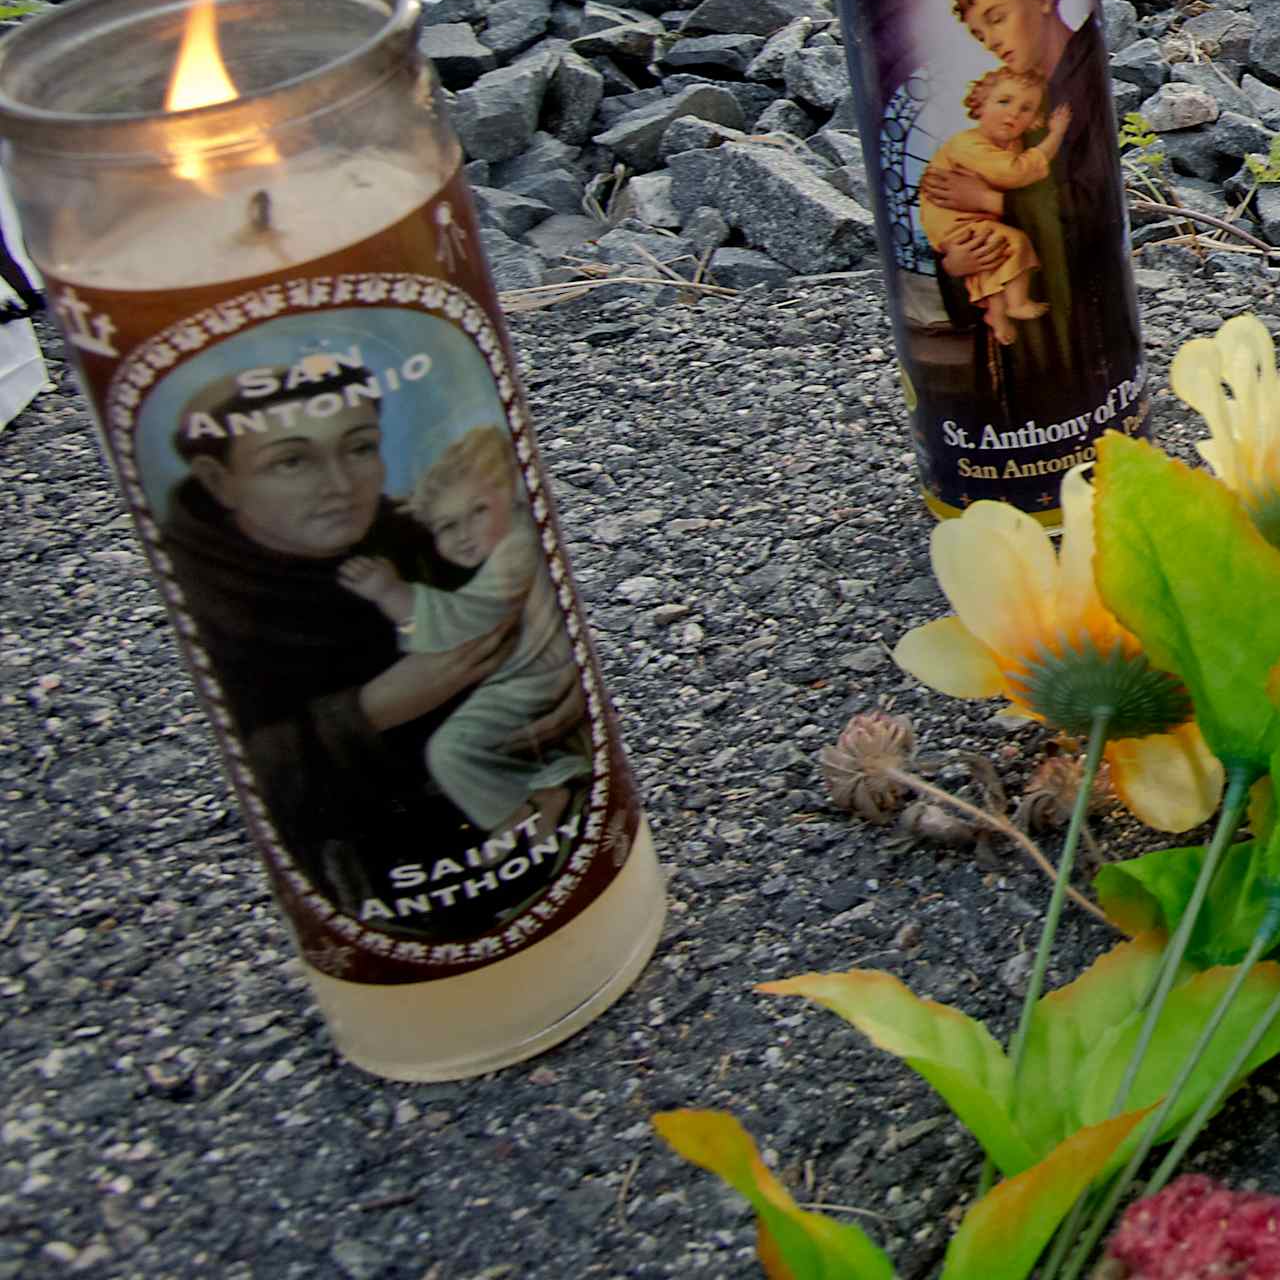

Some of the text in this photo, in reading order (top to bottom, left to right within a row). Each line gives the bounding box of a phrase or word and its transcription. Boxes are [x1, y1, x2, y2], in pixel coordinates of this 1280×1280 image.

[186, 352, 433, 439] ANTONIO
[236, 344, 364, 398] SAN
[943, 420, 976, 449] St.
[978, 413, 1093, 450] Anthony
[1093, 388, 1120, 425] of
[957, 457, 998, 480] San
[1001, 444, 1097, 480] Antonio
[359, 814, 582, 920] ANTHONY
[388, 811, 543, 889] SAINT
